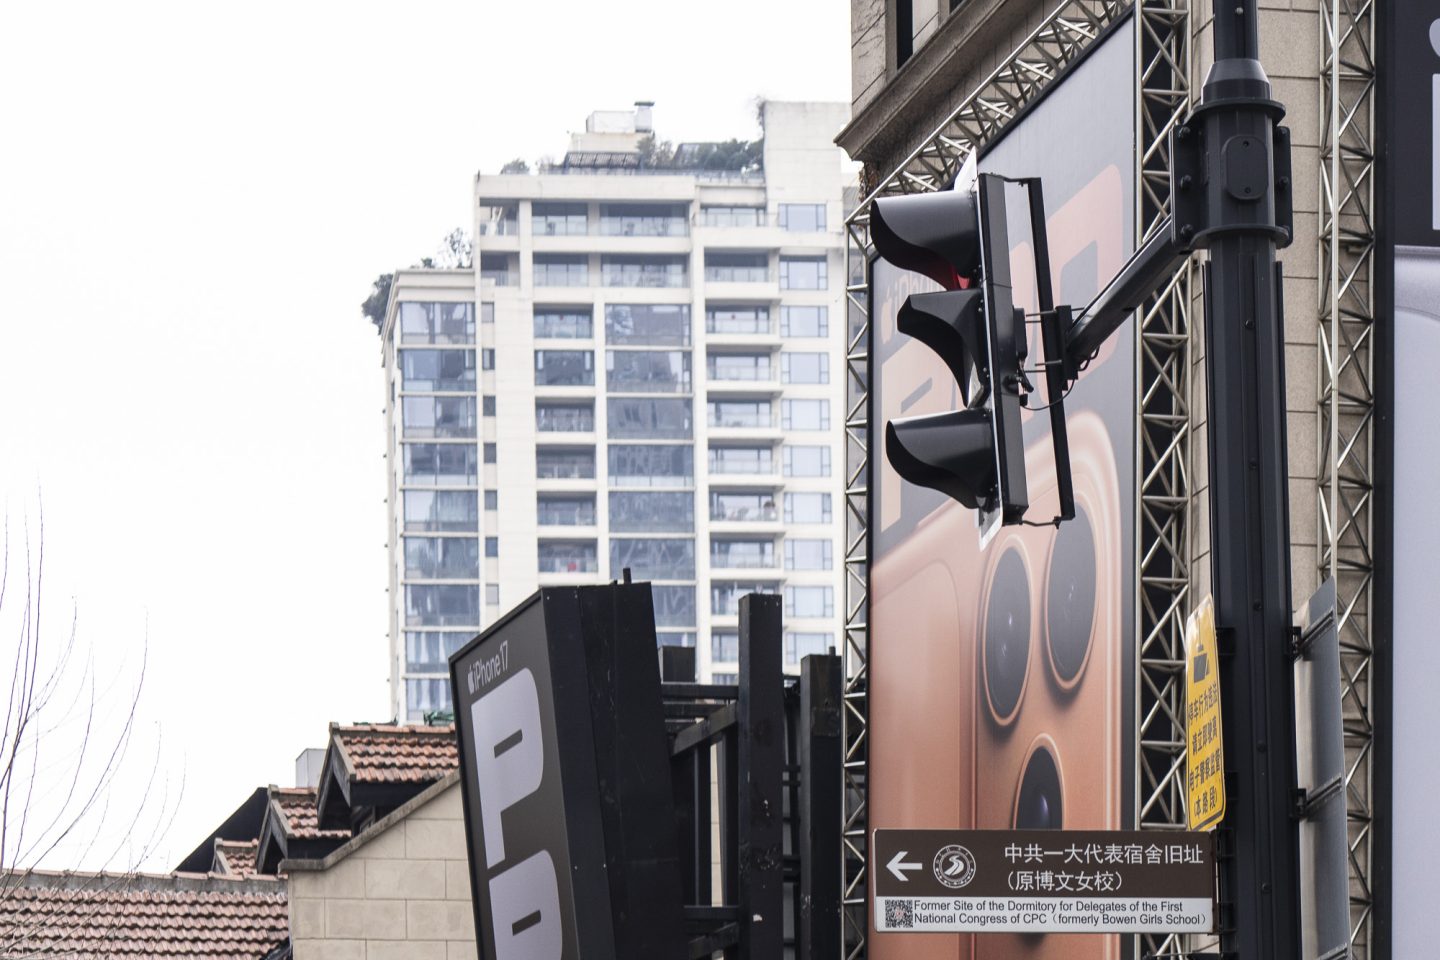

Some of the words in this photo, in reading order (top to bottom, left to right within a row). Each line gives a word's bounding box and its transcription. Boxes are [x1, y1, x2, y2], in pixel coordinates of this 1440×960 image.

[473, 653, 501, 691] iPhone
[500, 640, 508, 673] 17
[1004, 843, 1204, 865] 中共一大代表宿舍旧址
[1008, 870, 1123, 892] （原博文女校）
[914, 900, 951, 911] Former
[953, 900, 974, 911] Site
[976, 900, 986, 911] of
[989, 900, 1004, 911] the
[1007, 901, 1056, 914] Dormitory
[1059, 901, 1073, 912] for
[1076, 901, 1127, 914] Delegates
[1129, 902, 1140, 912] of
[1142, 902, 1158, 912] the
[1161, 902, 1183, 912] First
[914, 913, 956, 924] National
[959, 913, 1007, 926] Congress
[1010, 913, 1020, 924] of
[1023, 913, 1047, 924] CPC
[1102, 914, 1137, 925] Bowen
[1140, 914, 1163, 925] Girls
